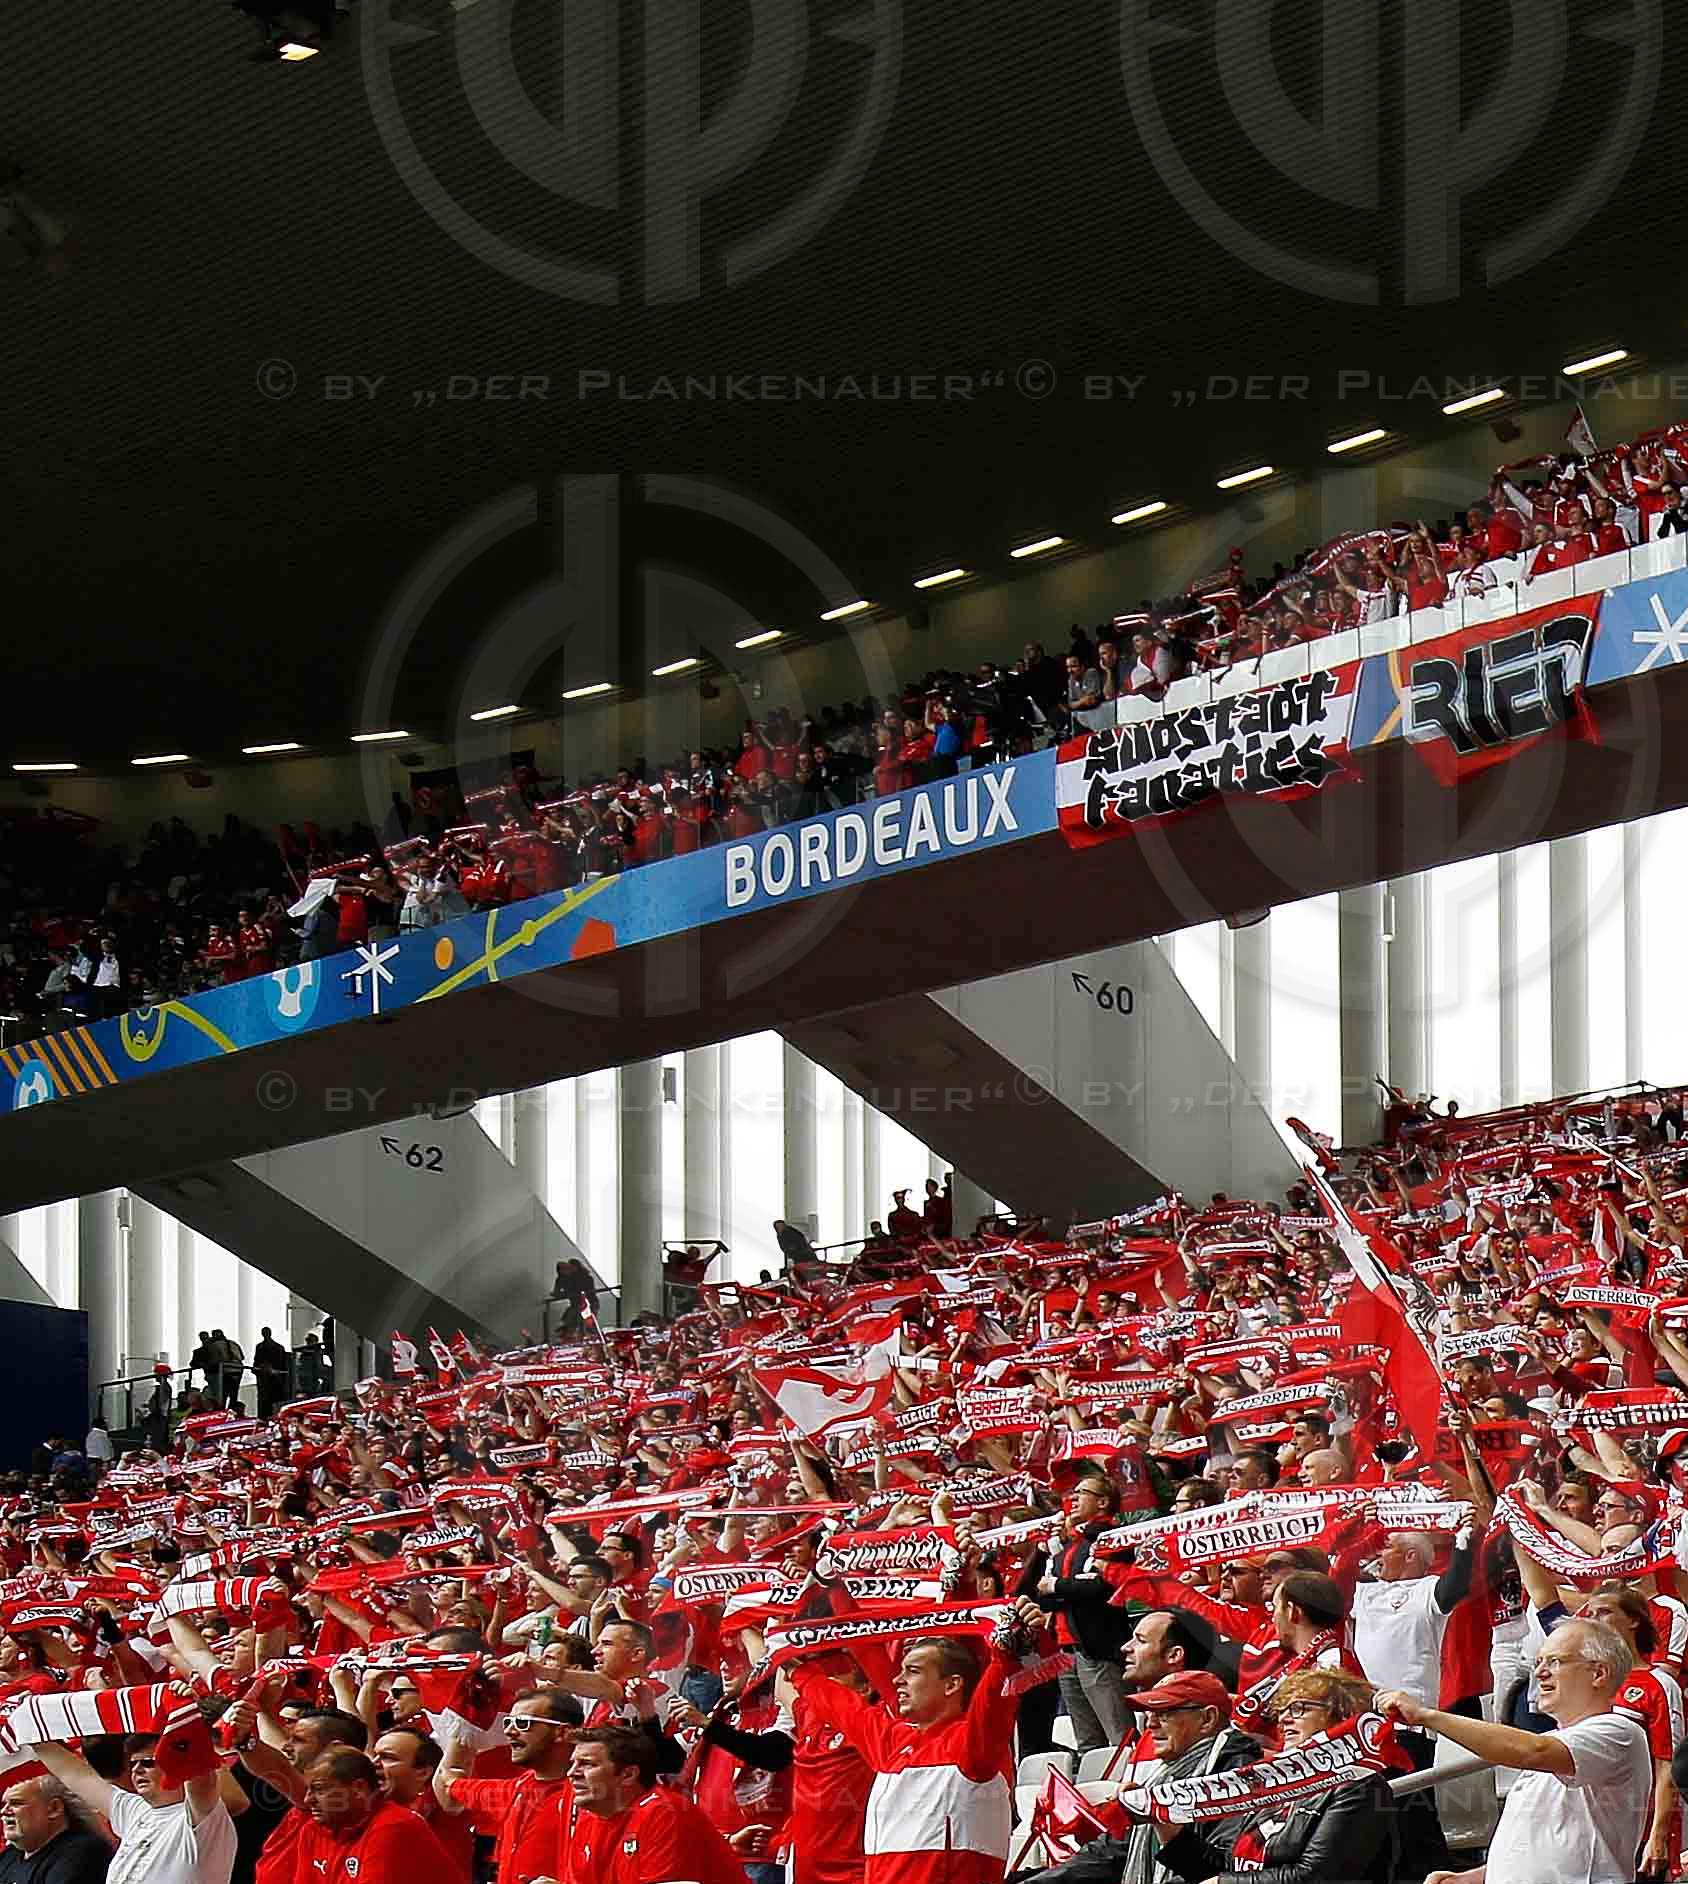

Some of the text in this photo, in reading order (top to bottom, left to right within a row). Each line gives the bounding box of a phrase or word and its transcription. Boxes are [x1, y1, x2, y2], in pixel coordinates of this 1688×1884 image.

[724, 764, 1019, 907] BORDEAUX
[1095, 980, 1132, 1014] 60
[404, 1143, 444, 1175] 62
[1572, 1287, 1657, 1309] ÖSTERREICH
[1182, 1517, 1321, 1557] ÖSTERREICH
[1255, 1733, 1363, 1788] REICH!
